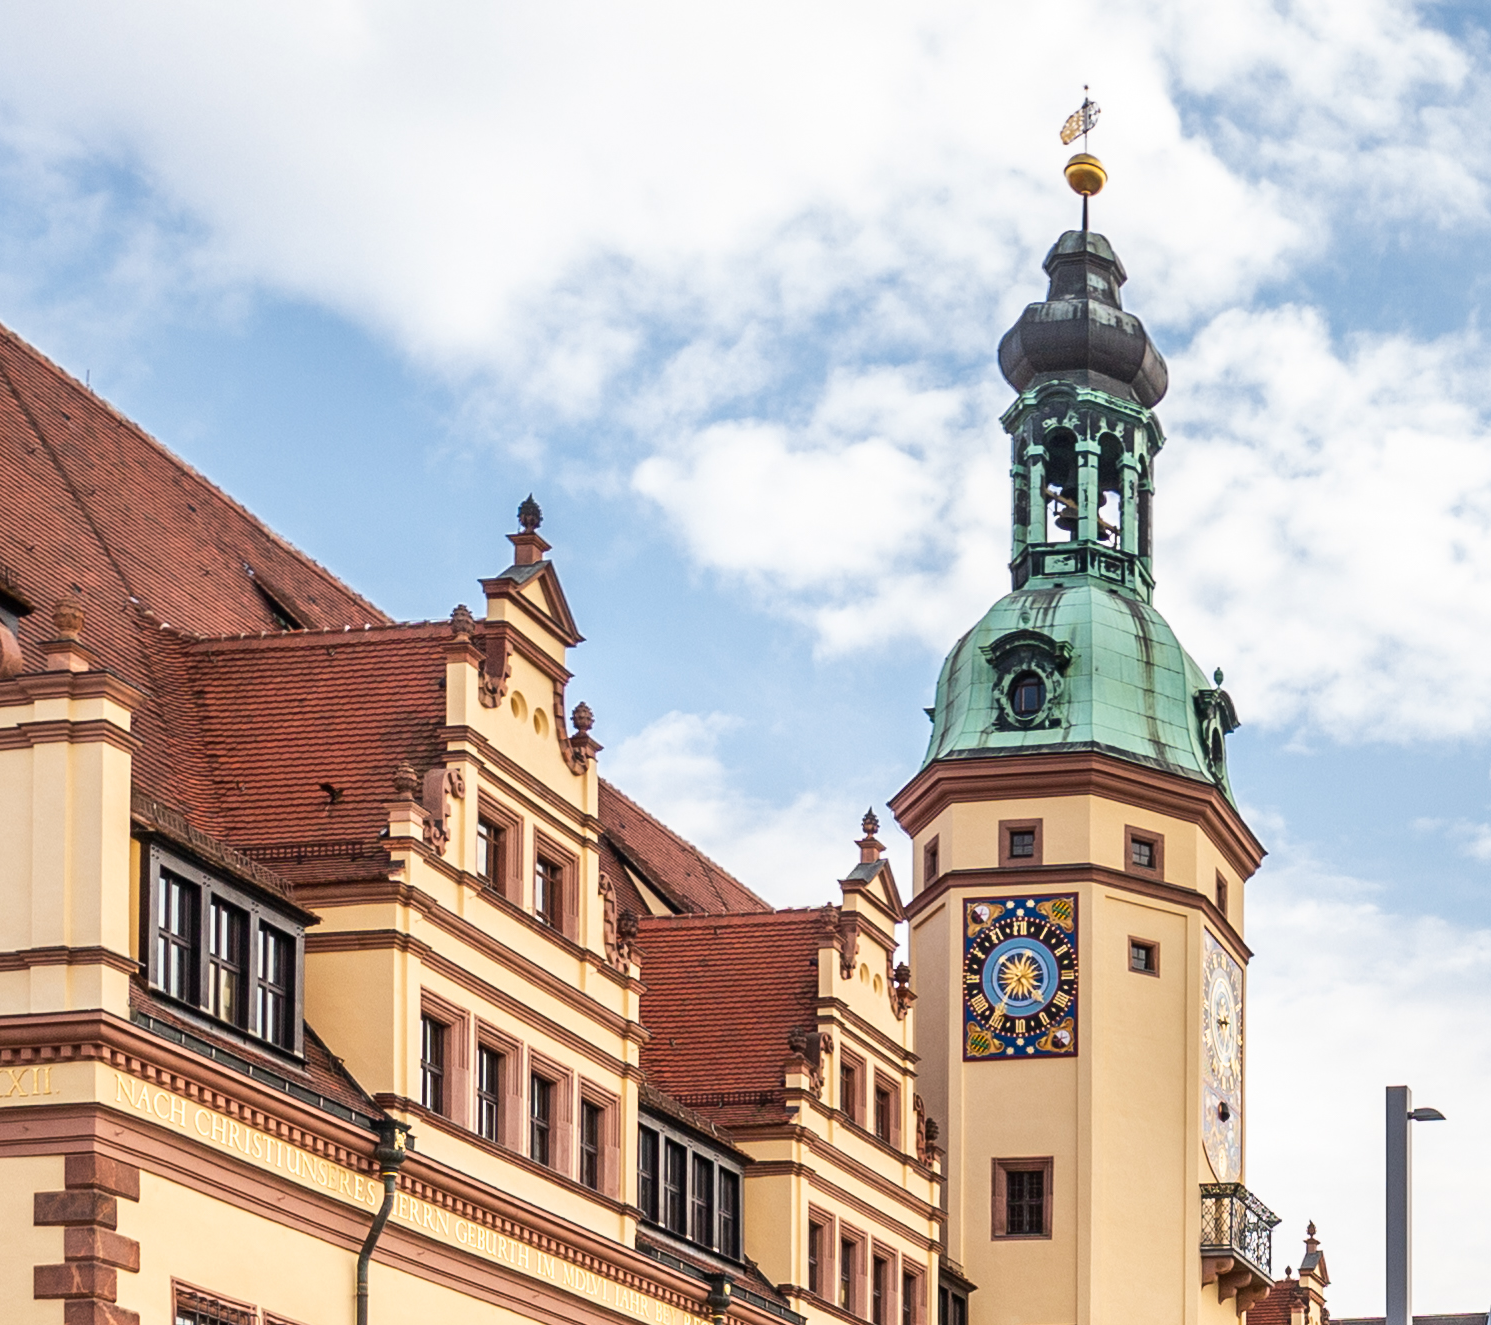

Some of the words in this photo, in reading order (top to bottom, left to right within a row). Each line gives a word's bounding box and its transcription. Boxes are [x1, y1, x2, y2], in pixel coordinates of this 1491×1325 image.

[114, 1073, 187, 1128] NACH
[194, 1108, 282, 1168] CHRISTI
[285, 1146, 376, 1206] UNSERES
[455, 1220, 530, 1270] GEBURTH
[536, 1251, 555, 1279] IM
